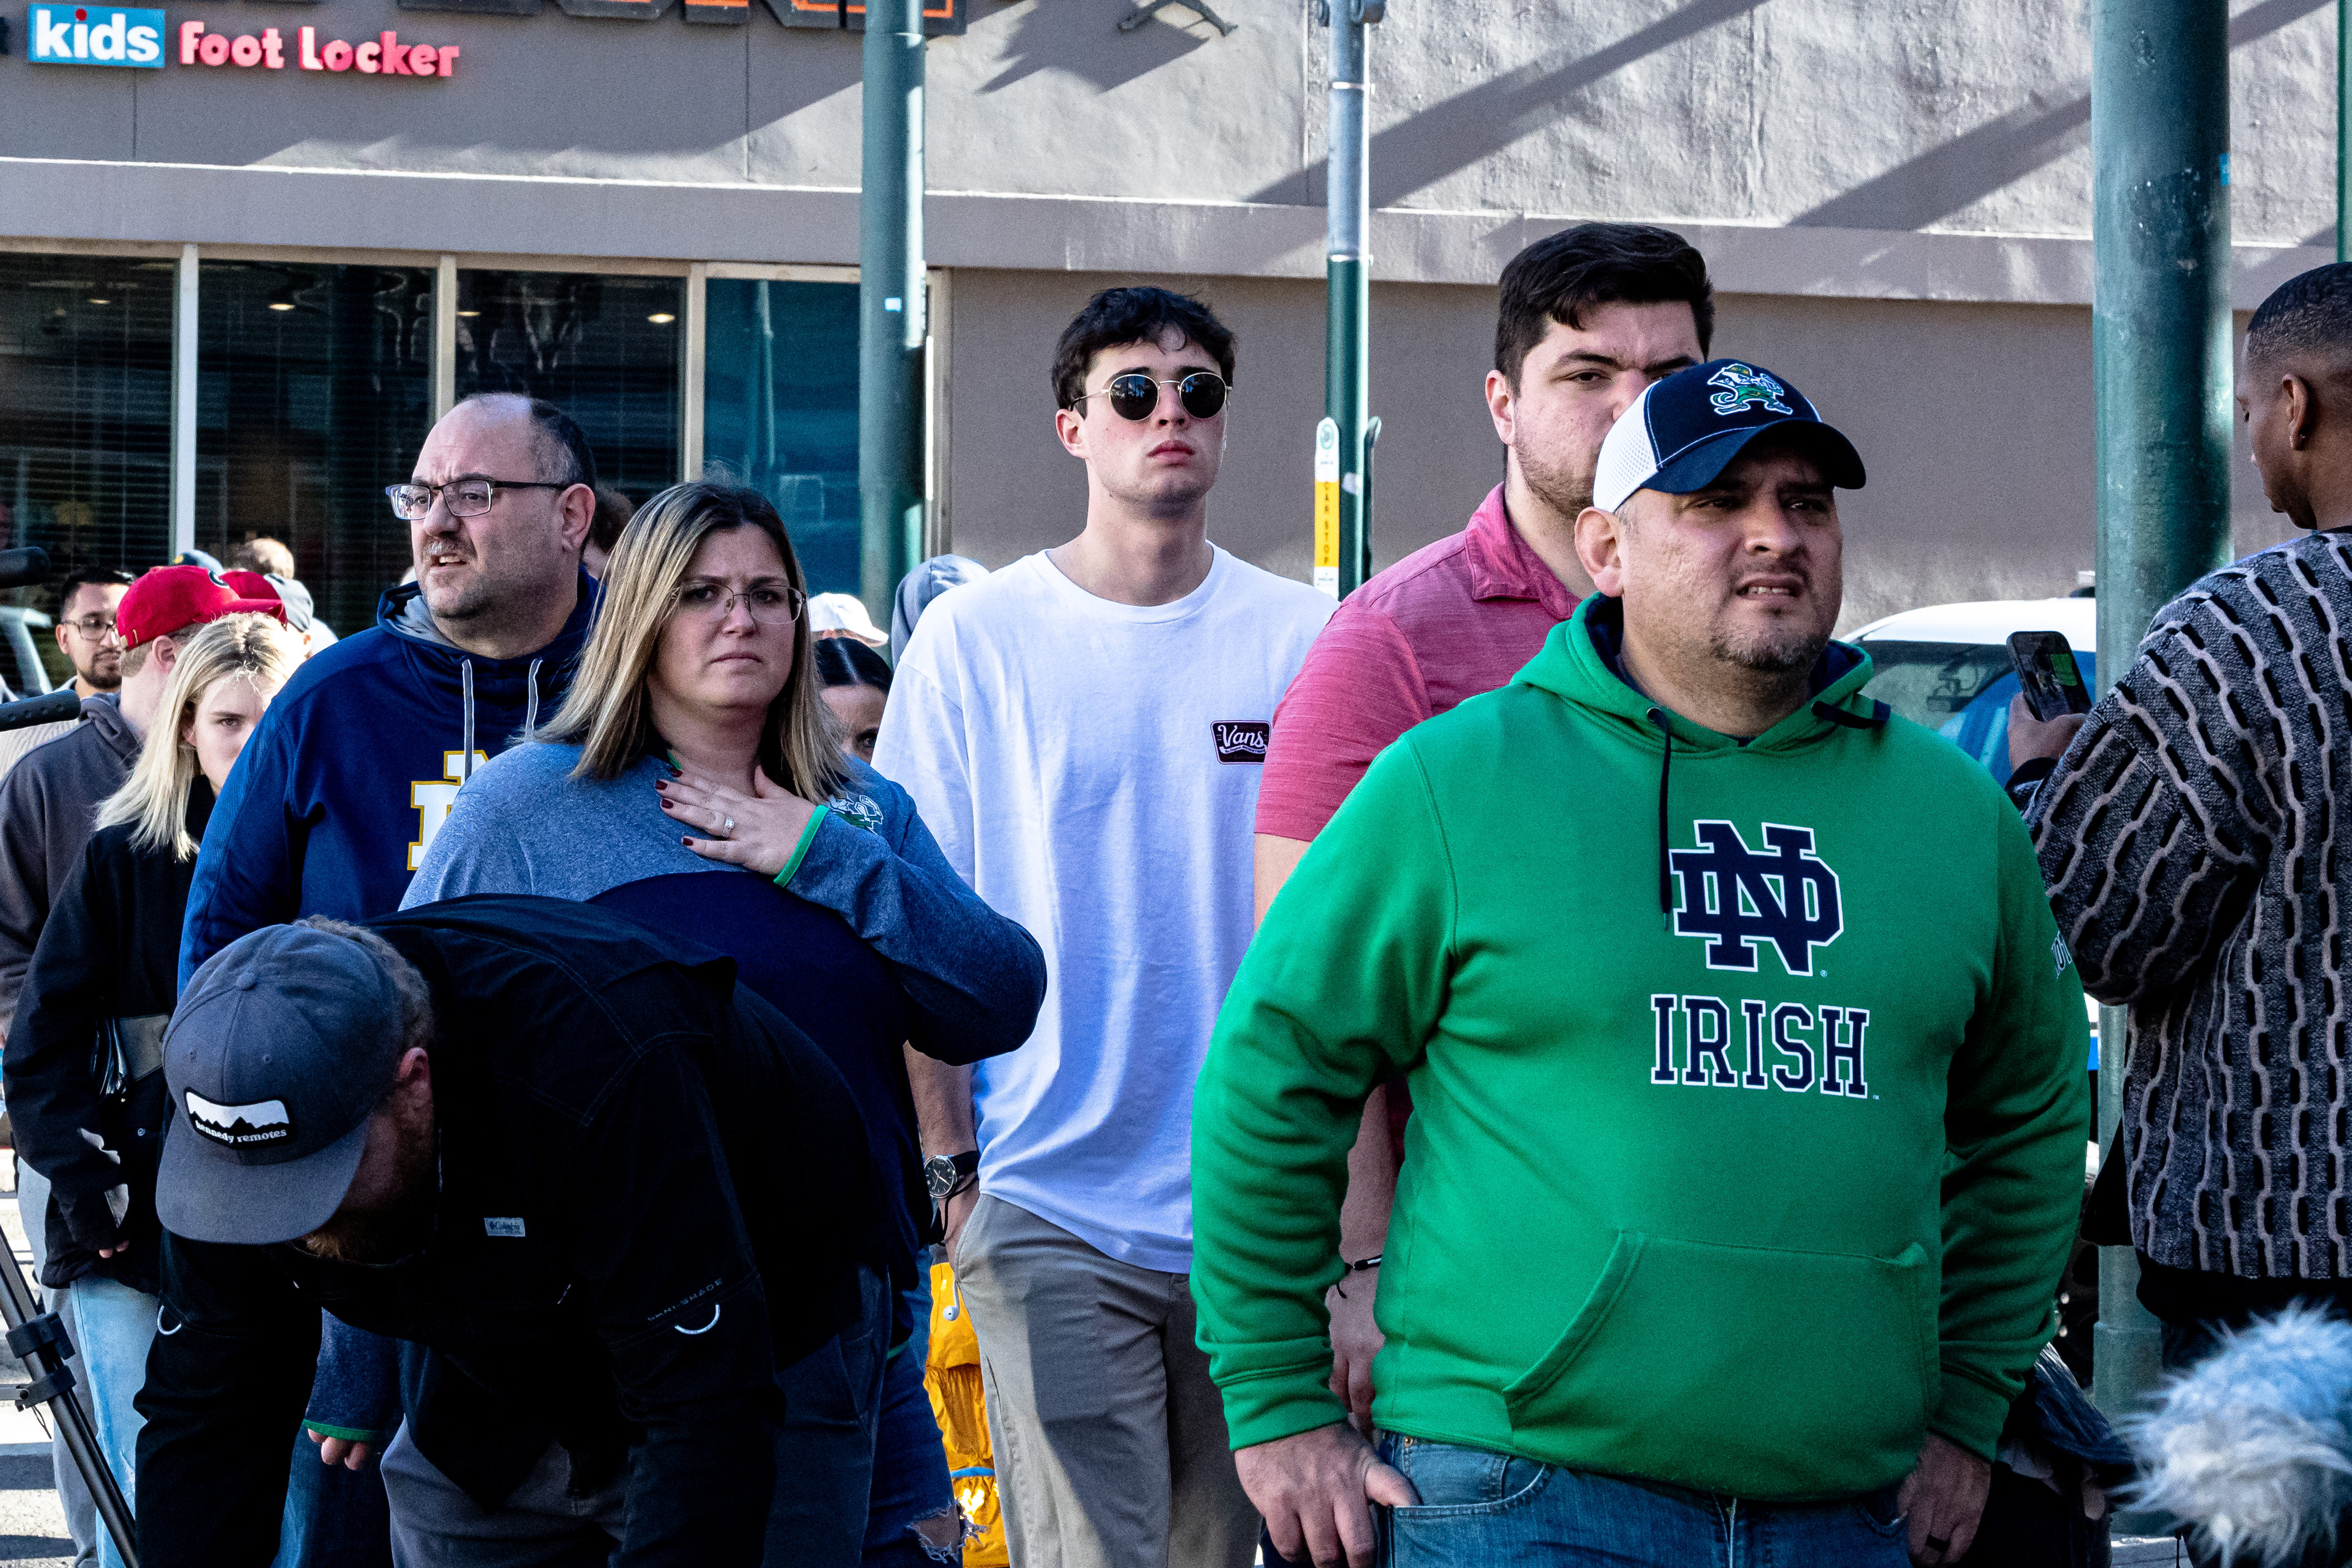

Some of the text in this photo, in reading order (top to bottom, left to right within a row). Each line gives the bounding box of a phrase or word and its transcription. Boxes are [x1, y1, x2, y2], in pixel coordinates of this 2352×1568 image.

[36, 8, 161, 62] kids
[298, 26, 460, 77] Locker
[1218, 725, 1264, 748] Vans
[1650, 993, 1870, 1099] IRISH
[237, 1129, 287, 1143] remotes
